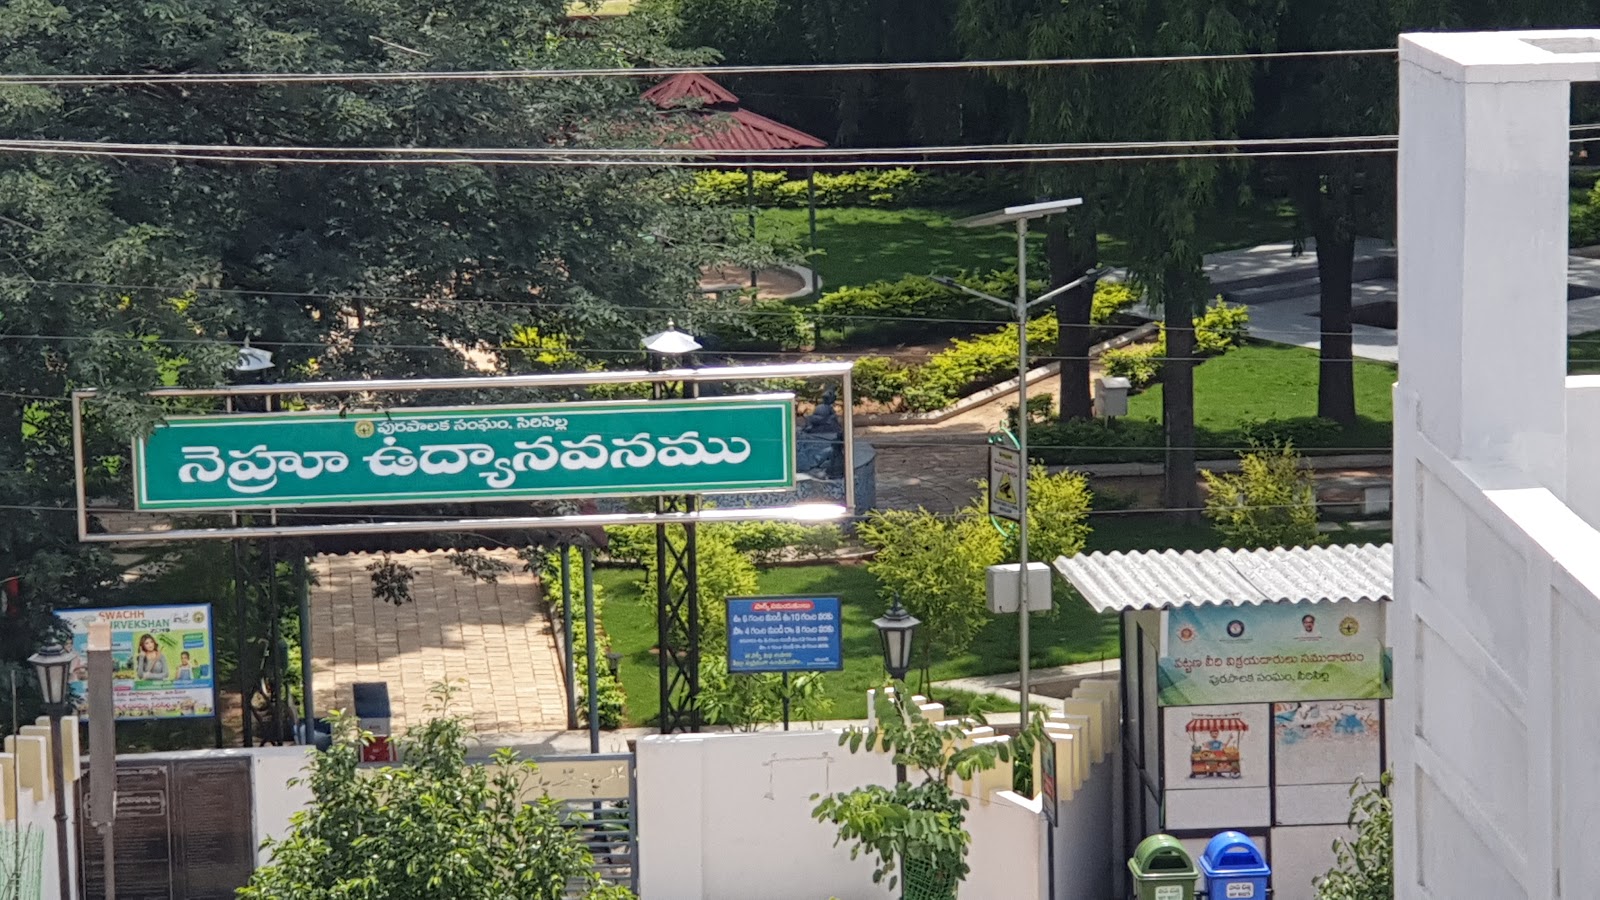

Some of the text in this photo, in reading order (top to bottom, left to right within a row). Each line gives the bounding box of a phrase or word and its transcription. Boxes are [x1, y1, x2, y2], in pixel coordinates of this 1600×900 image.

[378, 420, 450, 434] పురపాలక
[517, 416, 569, 431] సిరిసిల్ల
[363, 431, 752, 488] ఉద్యానవనము
[99, 610, 145, 621] SWACHH
[109, 618, 170, 629] RVEKSHAN
